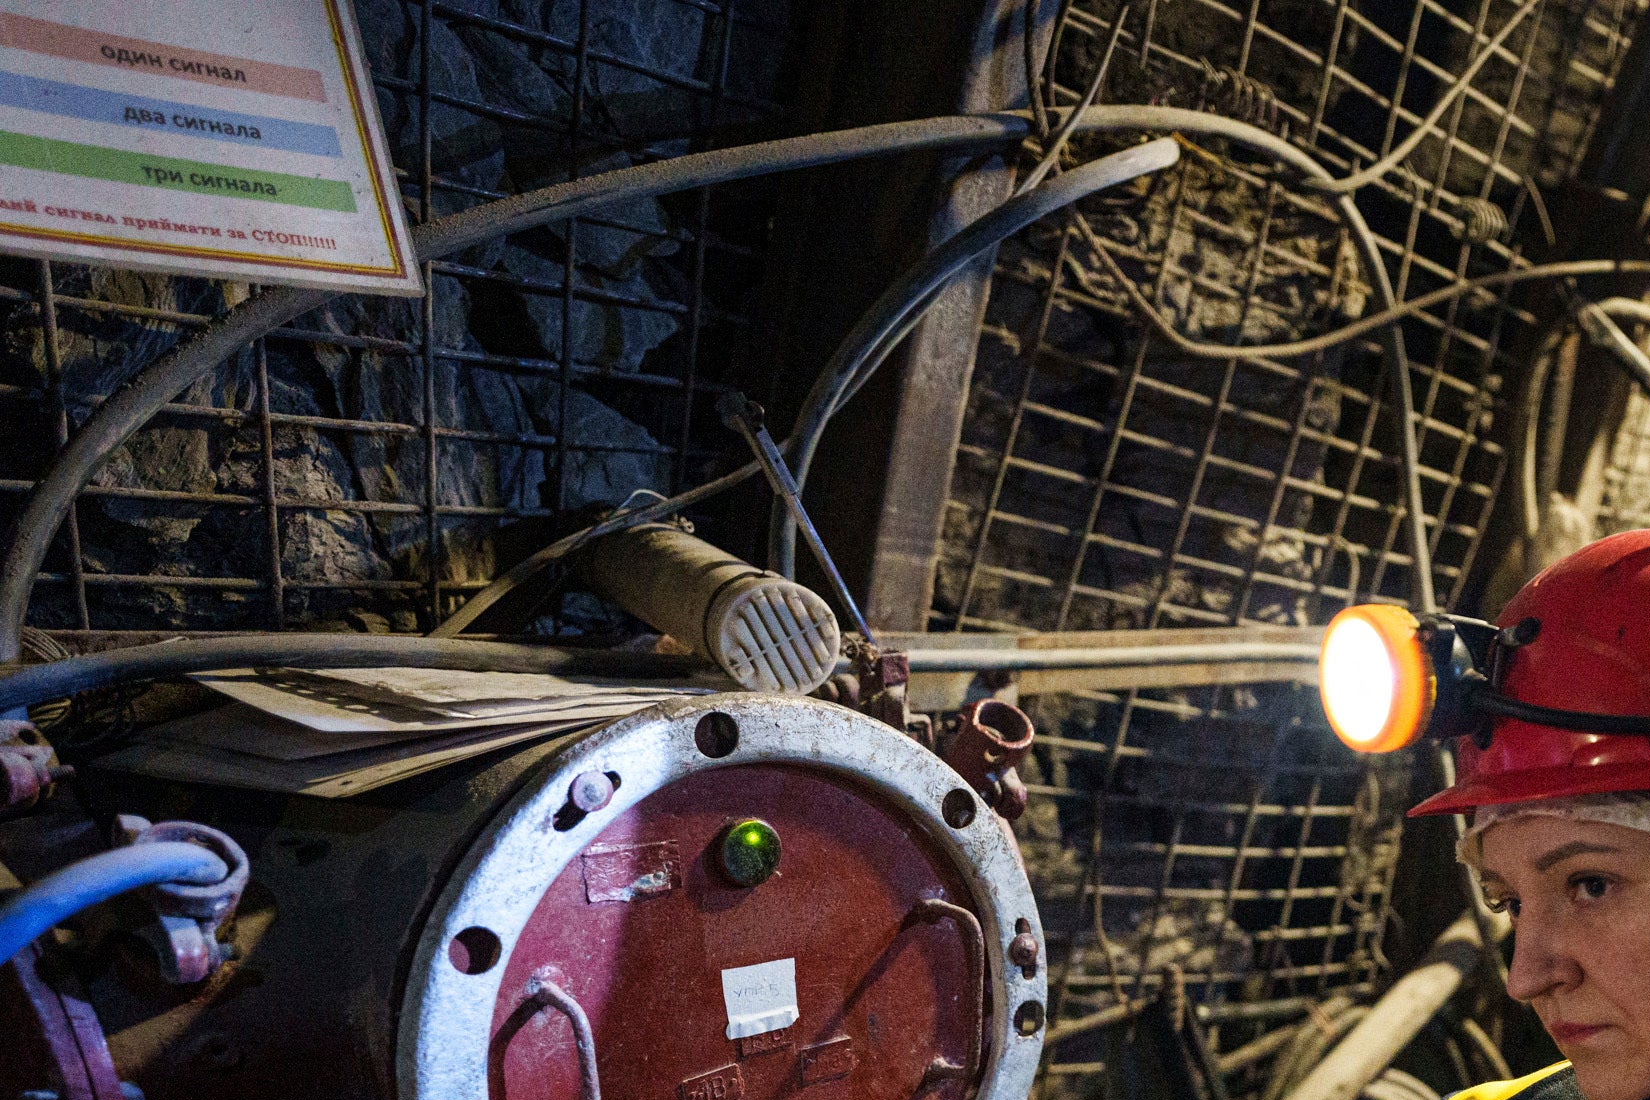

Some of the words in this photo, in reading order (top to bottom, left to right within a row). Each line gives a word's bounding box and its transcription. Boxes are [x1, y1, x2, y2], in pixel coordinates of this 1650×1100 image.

[100, 44, 163, 67] один
[169, 57, 247, 83] сигнал
[124, 106, 166, 125] два
[172, 113, 262, 140] сигнала
[141, 165, 184, 184] три
[189, 172, 278, 196] сигнала
[44, 204, 117, 225] сигнал
[121, 216, 222, 237] приймати
[227, 228, 247, 240] за
